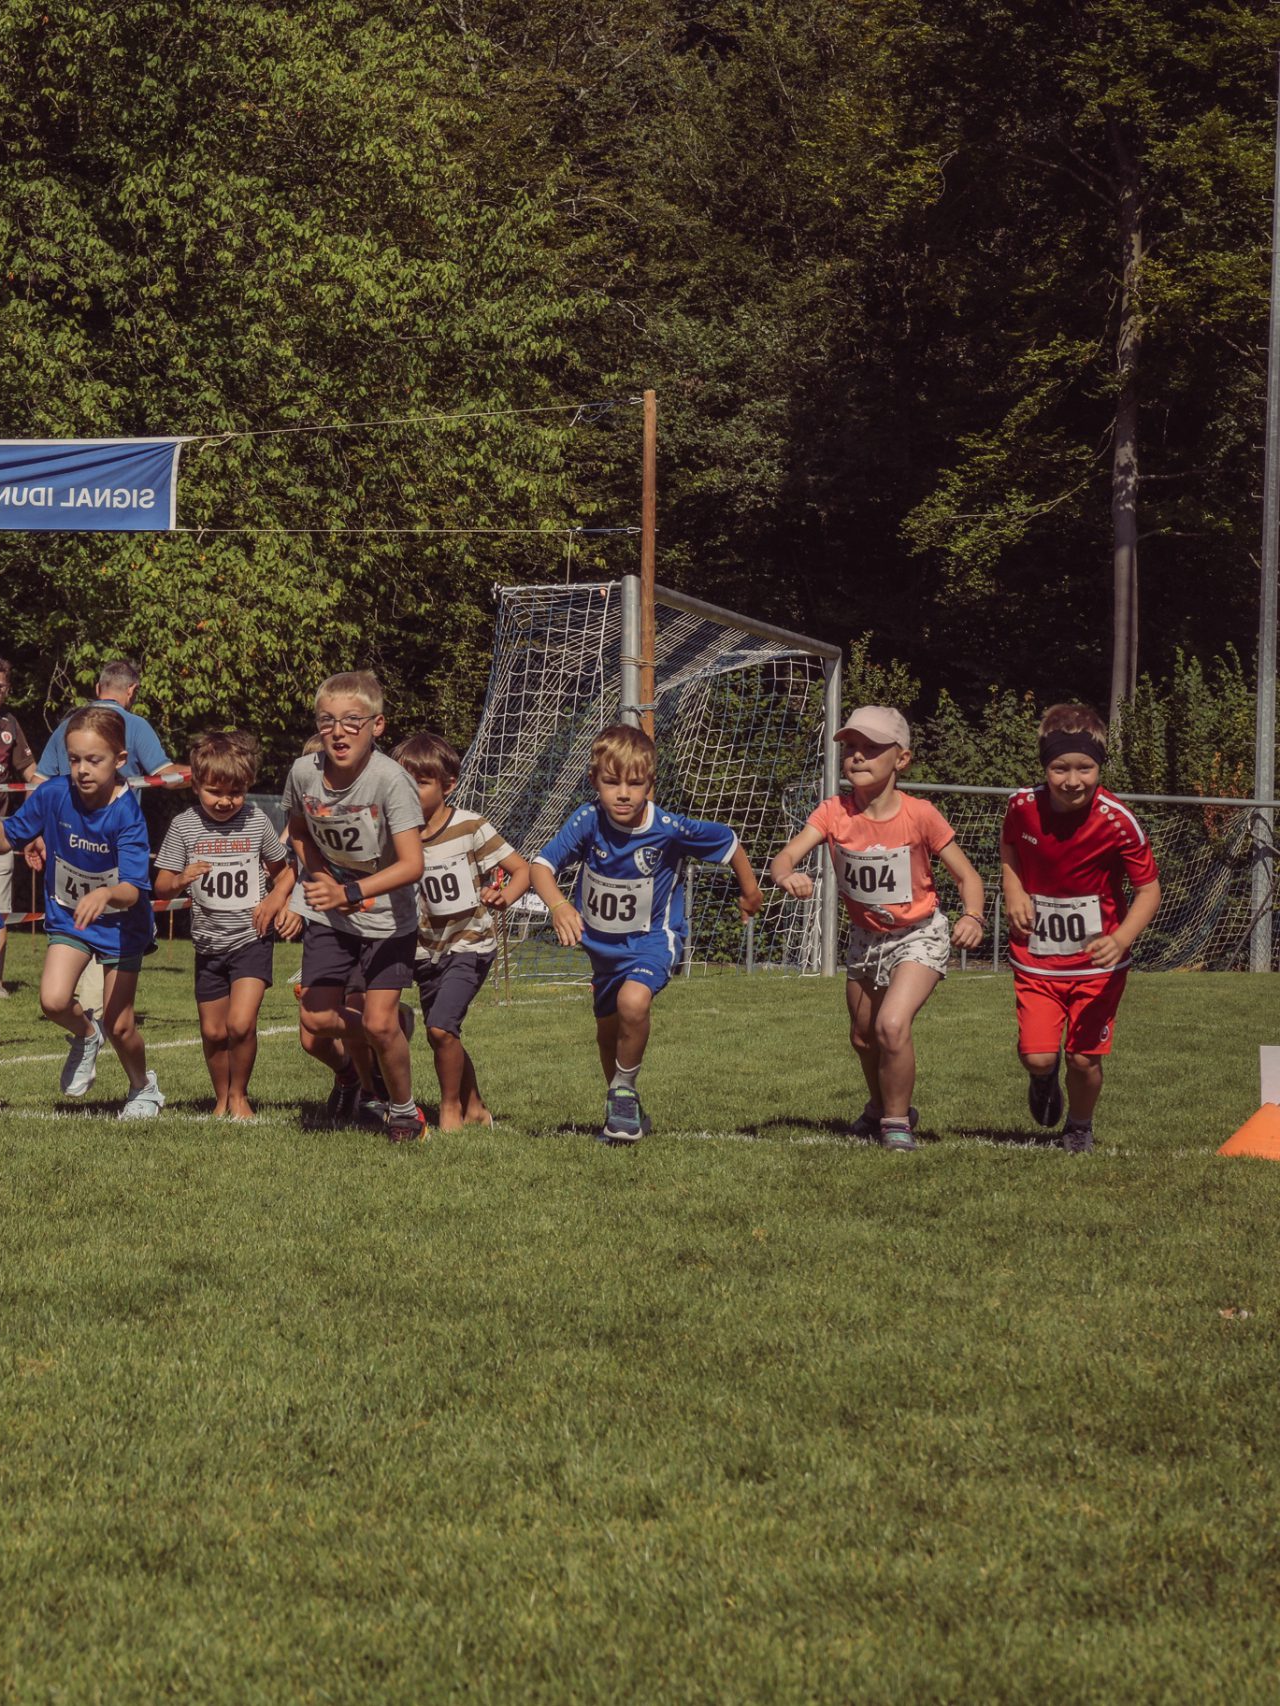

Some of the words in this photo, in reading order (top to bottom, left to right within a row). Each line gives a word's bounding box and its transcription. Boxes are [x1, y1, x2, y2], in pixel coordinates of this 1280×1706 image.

[69, 833, 110, 854] Emma
[312, 823, 363, 852] 402
[65, 876, 108, 900] 41
[200, 869, 248, 899] 408
[422, 873, 460, 904] 09
[844, 862, 896, 893] 404
[587, 887, 637, 921] 403
[1033, 911, 1086, 942] 400
